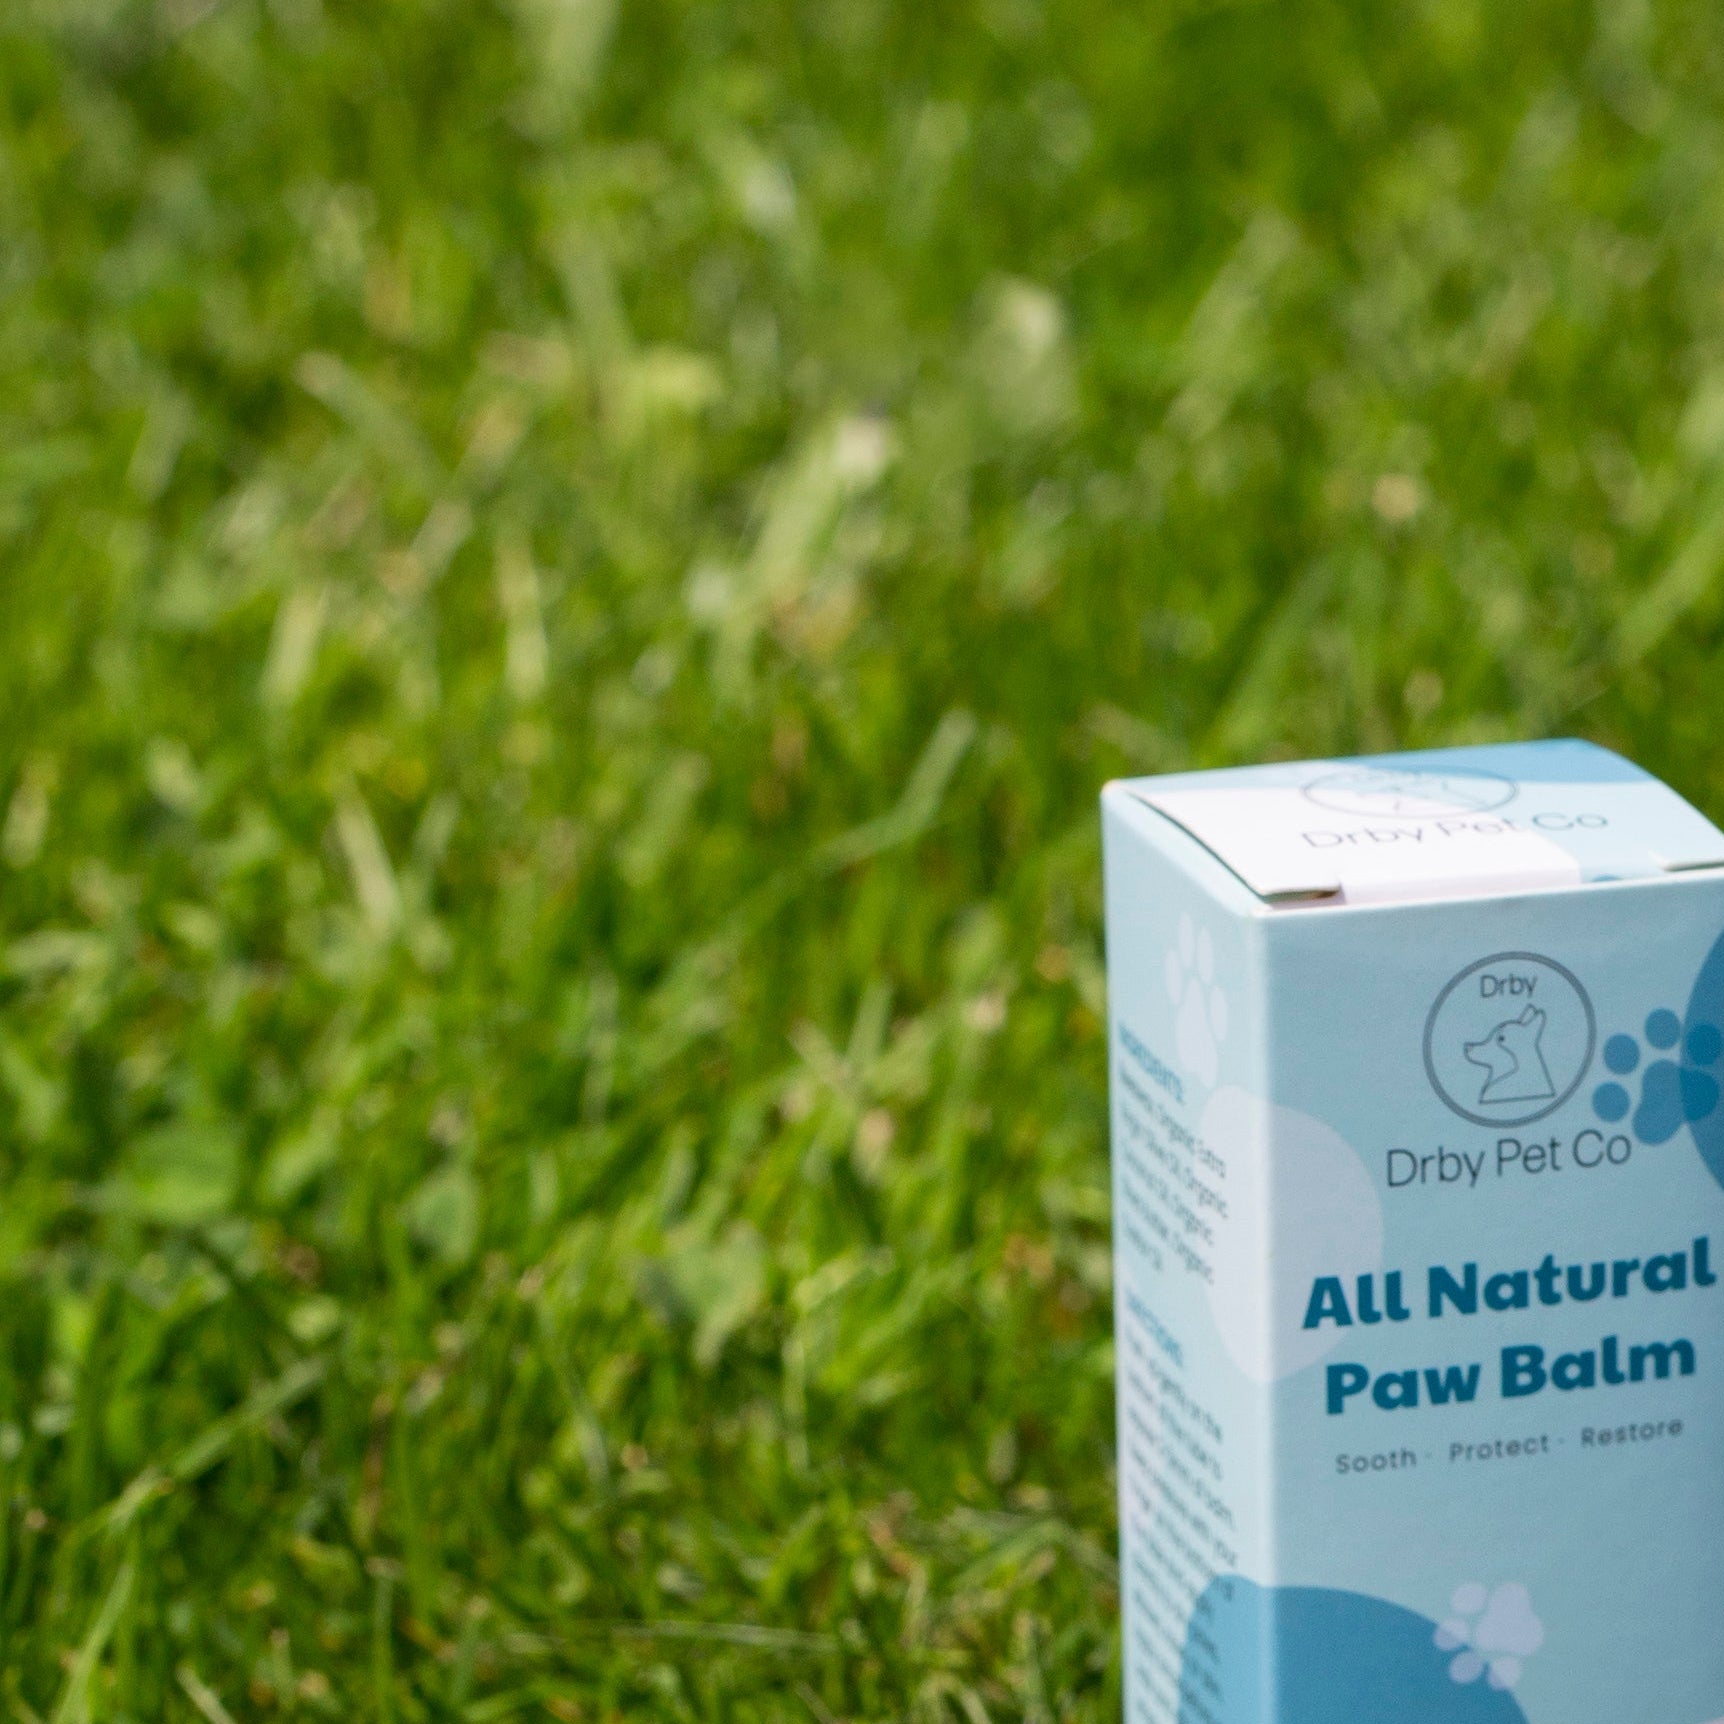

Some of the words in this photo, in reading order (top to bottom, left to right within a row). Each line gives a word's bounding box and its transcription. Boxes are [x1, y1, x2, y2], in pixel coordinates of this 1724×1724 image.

[1302, 825, 1424, 848] Drby
[1436, 817, 1520, 838] Pet
[1532, 812, 1609, 832] Co
[1480, 973, 1538, 999] Drby
[1387, 1145, 1486, 1188] Drby
[1497, 1136, 1562, 1176] Pet
[1571, 1129, 1632, 1168] Co
[1302, 1269, 1411, 1330] All
[1427, 1235, 1718, 1319] Natural
[1325, 1361, 1482, 1416] Paw
[1500, 1333, 1697, 1399] Balm
[1335, 1447, 1418, 1475] Sooth
[1448, 1433, 1550, 1463] Protect
[1580, 1418, 1684, 1448] Restore
